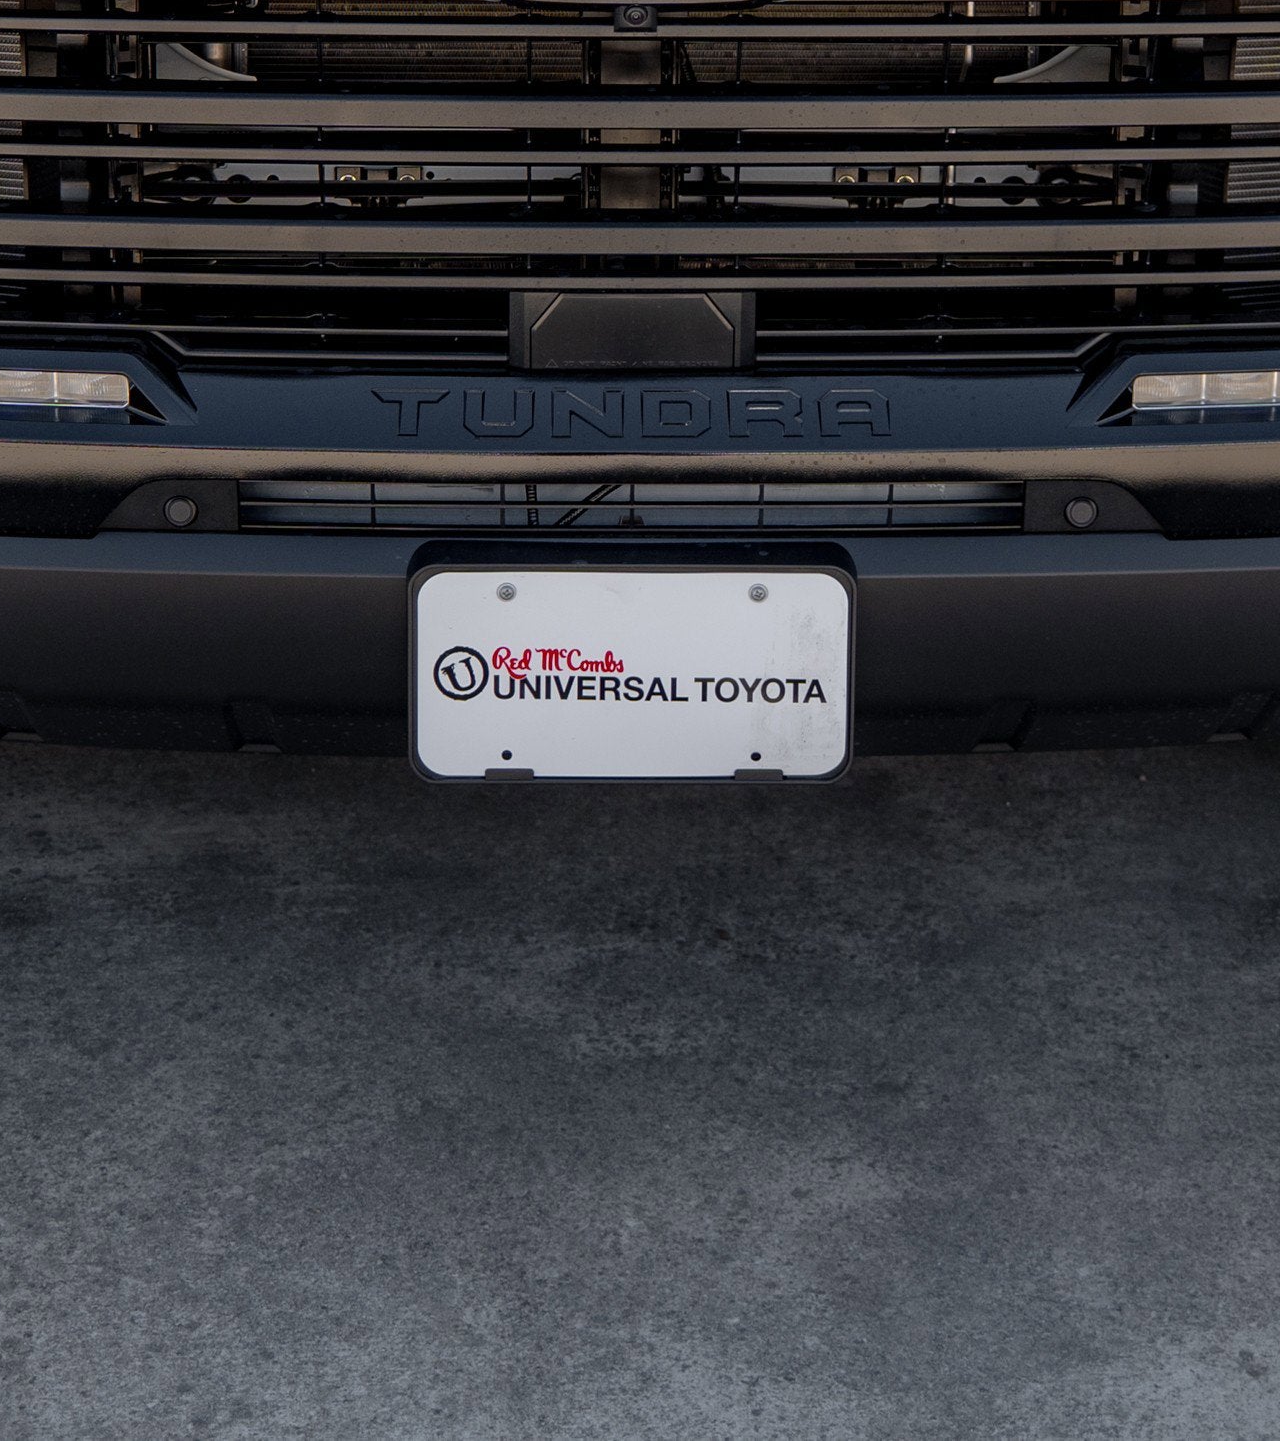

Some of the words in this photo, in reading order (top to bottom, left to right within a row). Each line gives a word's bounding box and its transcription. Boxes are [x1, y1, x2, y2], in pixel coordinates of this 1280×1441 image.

[371, 388, 892, 438] TUNDRA
[492, 646, 532, 680] Red
[535, 647, 624, 673] McCombs
[494, 675, 689, 702] UNIVERSAL
[695, 677, 827, 704] TOYOTA
